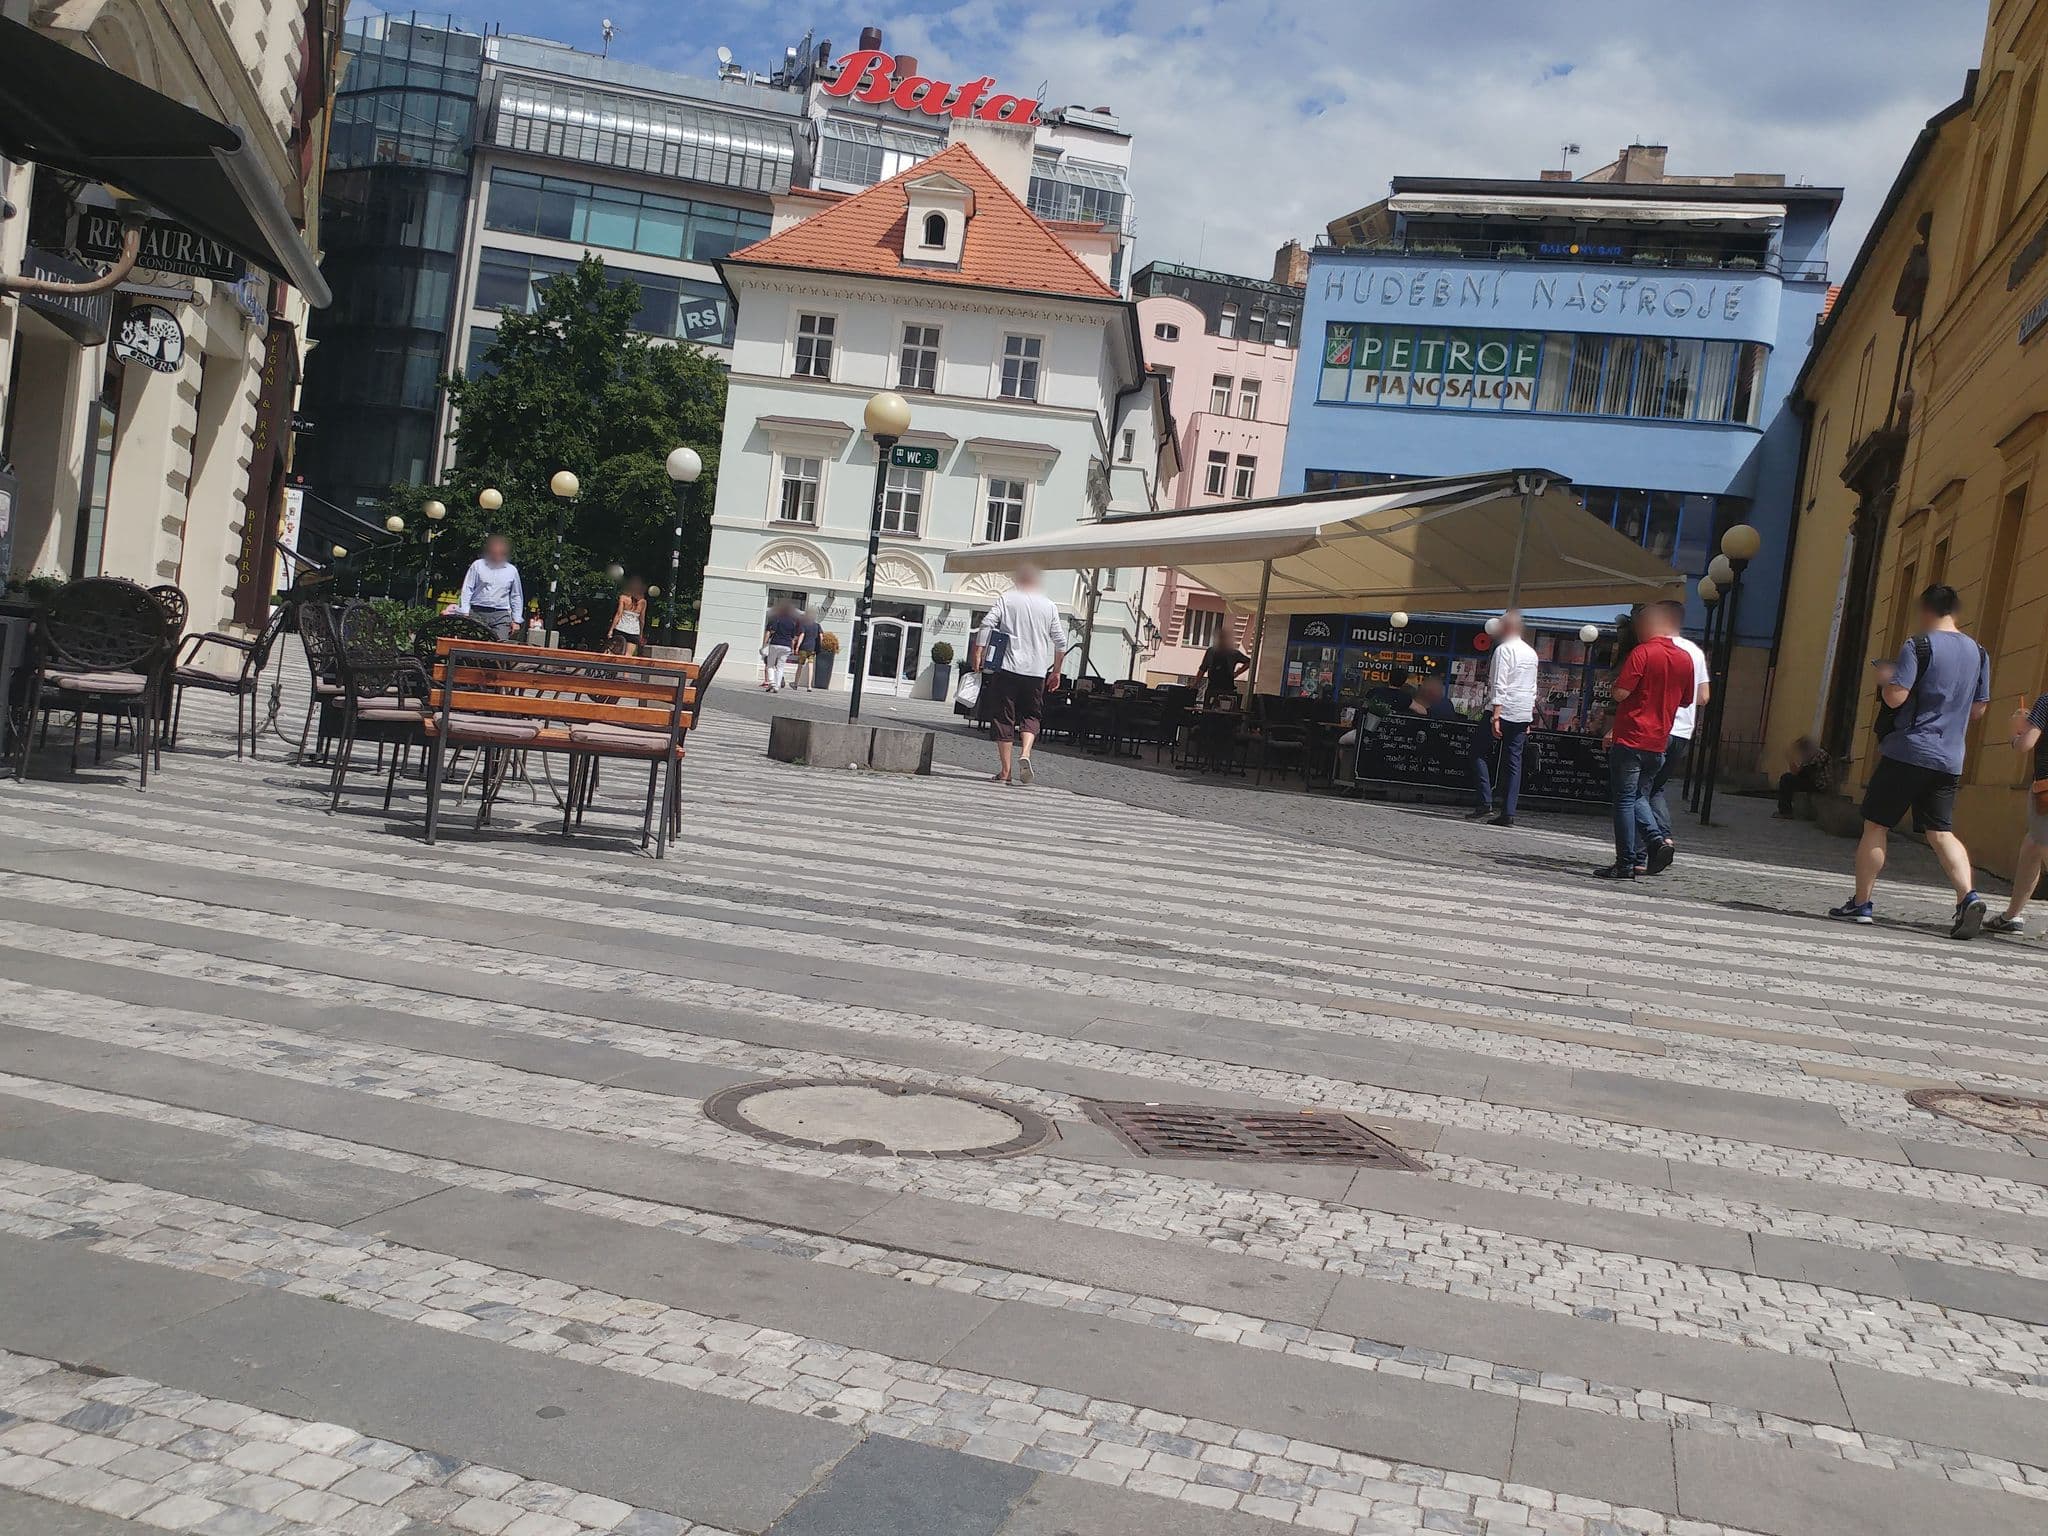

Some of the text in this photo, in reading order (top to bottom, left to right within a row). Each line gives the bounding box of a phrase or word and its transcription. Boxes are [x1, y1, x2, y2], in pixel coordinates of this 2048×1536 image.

[138, 255, 207, 277] CONDITION
[686, 309, 717, 329] RS
[265, 334, 280, 386] VEGAN
[1360, 337, 1537, 374] PETROF
[1364, 374, 1534, 401] PIANOSALON
[256, 421, 268, 450] RAW
[906, 451, 922, 464] WC
[240, 511, 256, 584] BISTRO
[1351, 627, 1448, 647] musicpoint
[1407, 664, 1432, 675] BILL
